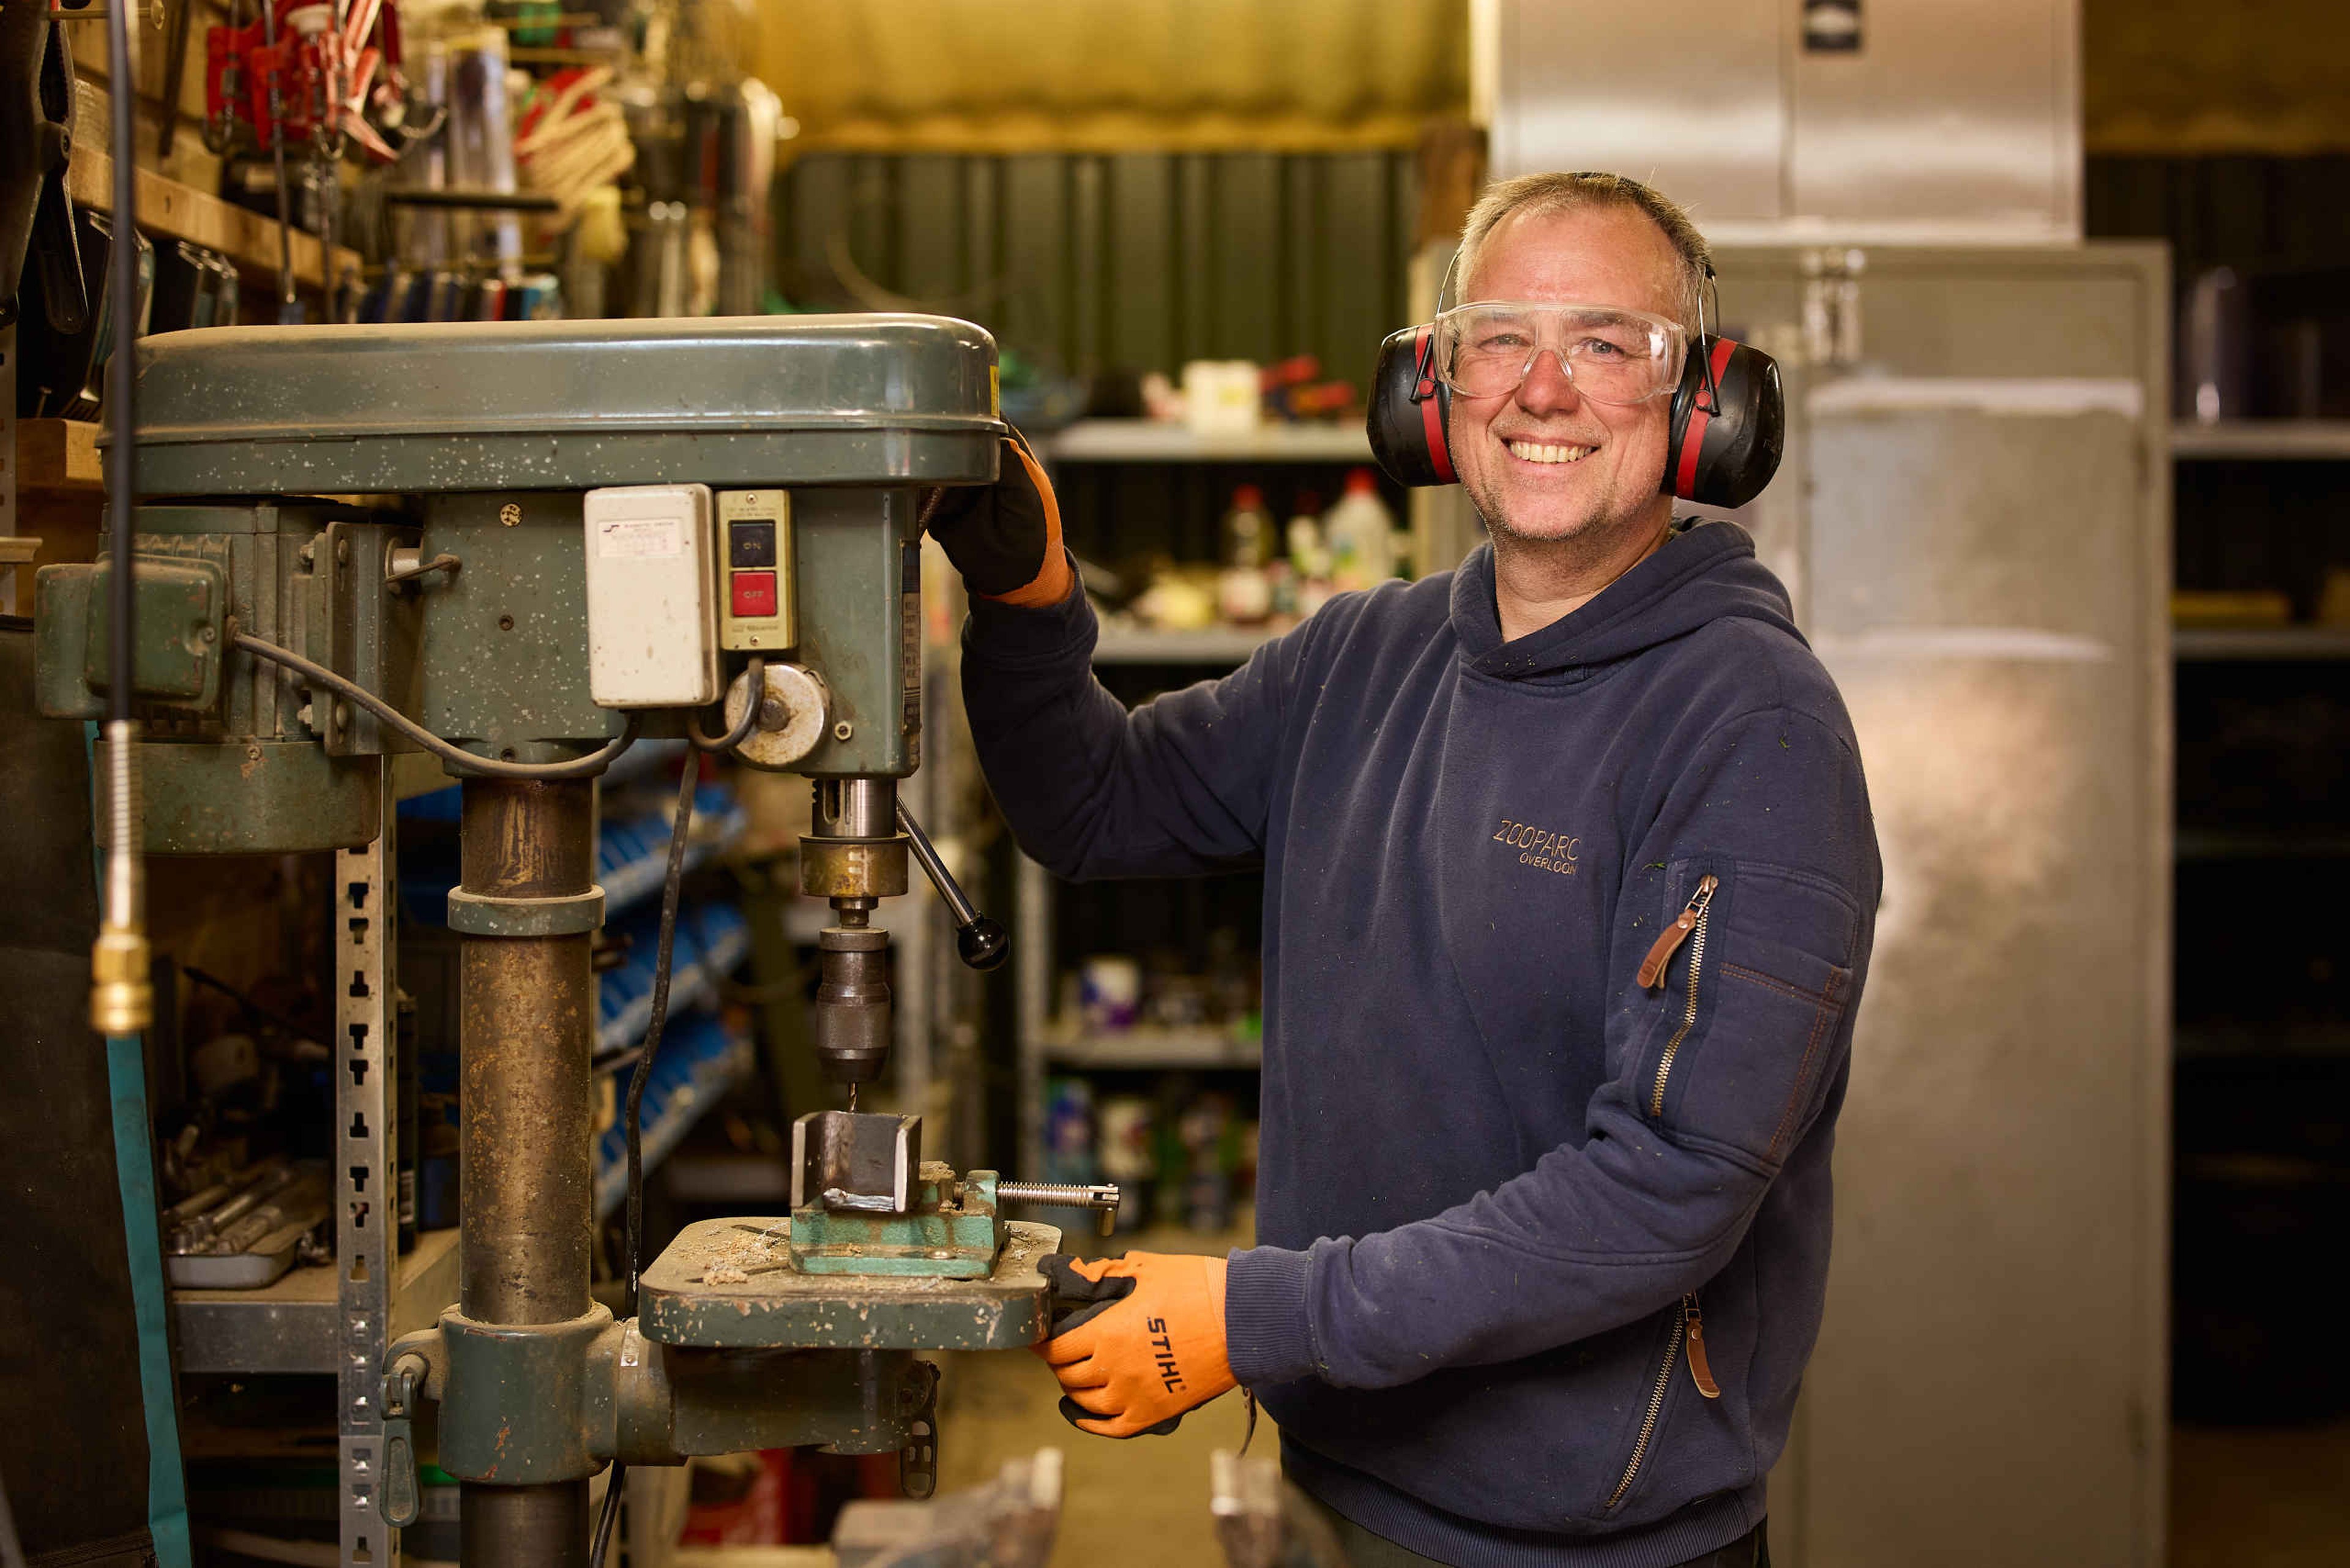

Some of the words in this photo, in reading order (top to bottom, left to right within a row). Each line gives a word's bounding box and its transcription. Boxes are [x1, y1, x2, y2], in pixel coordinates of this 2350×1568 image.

[743, 542, 762, 550] ON
[1493, 819, 1581, 861] ZOOPARC
[1520, 851, 1578, 876] OVERLOON
[1147, 1316, 1184, 1394] STIHL
